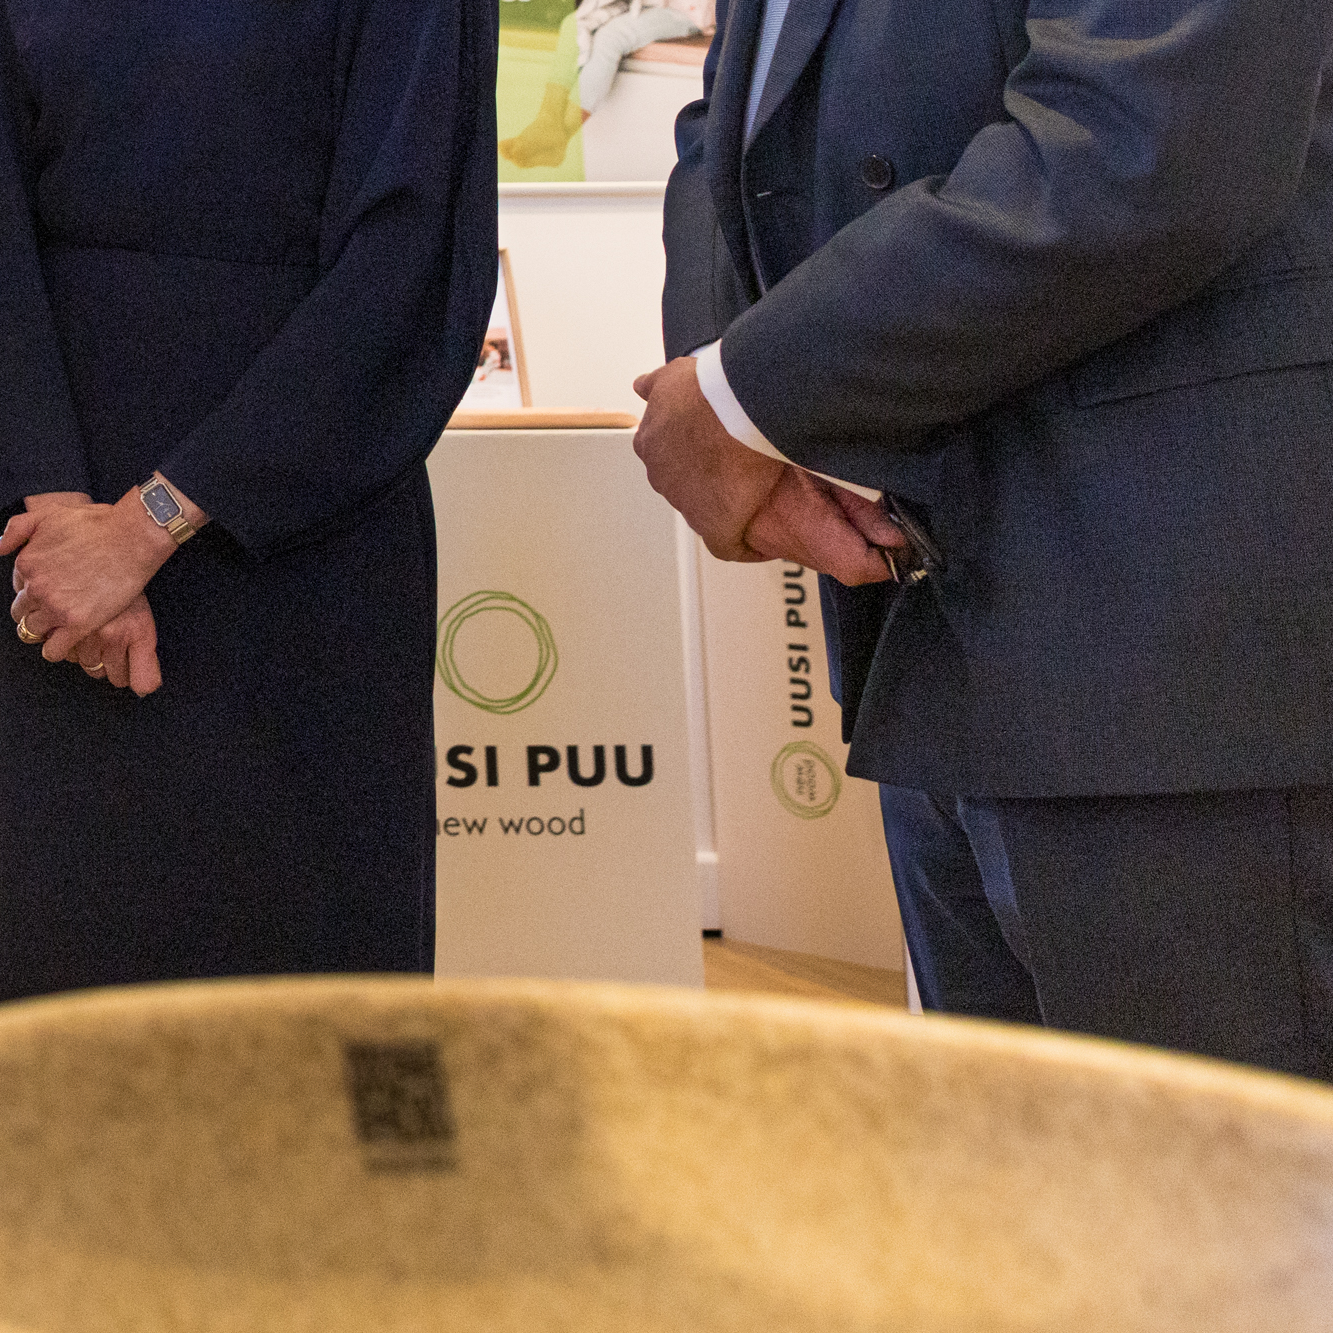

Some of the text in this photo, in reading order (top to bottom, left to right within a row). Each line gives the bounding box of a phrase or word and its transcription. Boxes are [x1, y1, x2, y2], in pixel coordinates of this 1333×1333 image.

[787, 643, 814, 728] UUSI
[434, 744, 654, 788] SI PUU
[499, 807, 586, 836] wood
